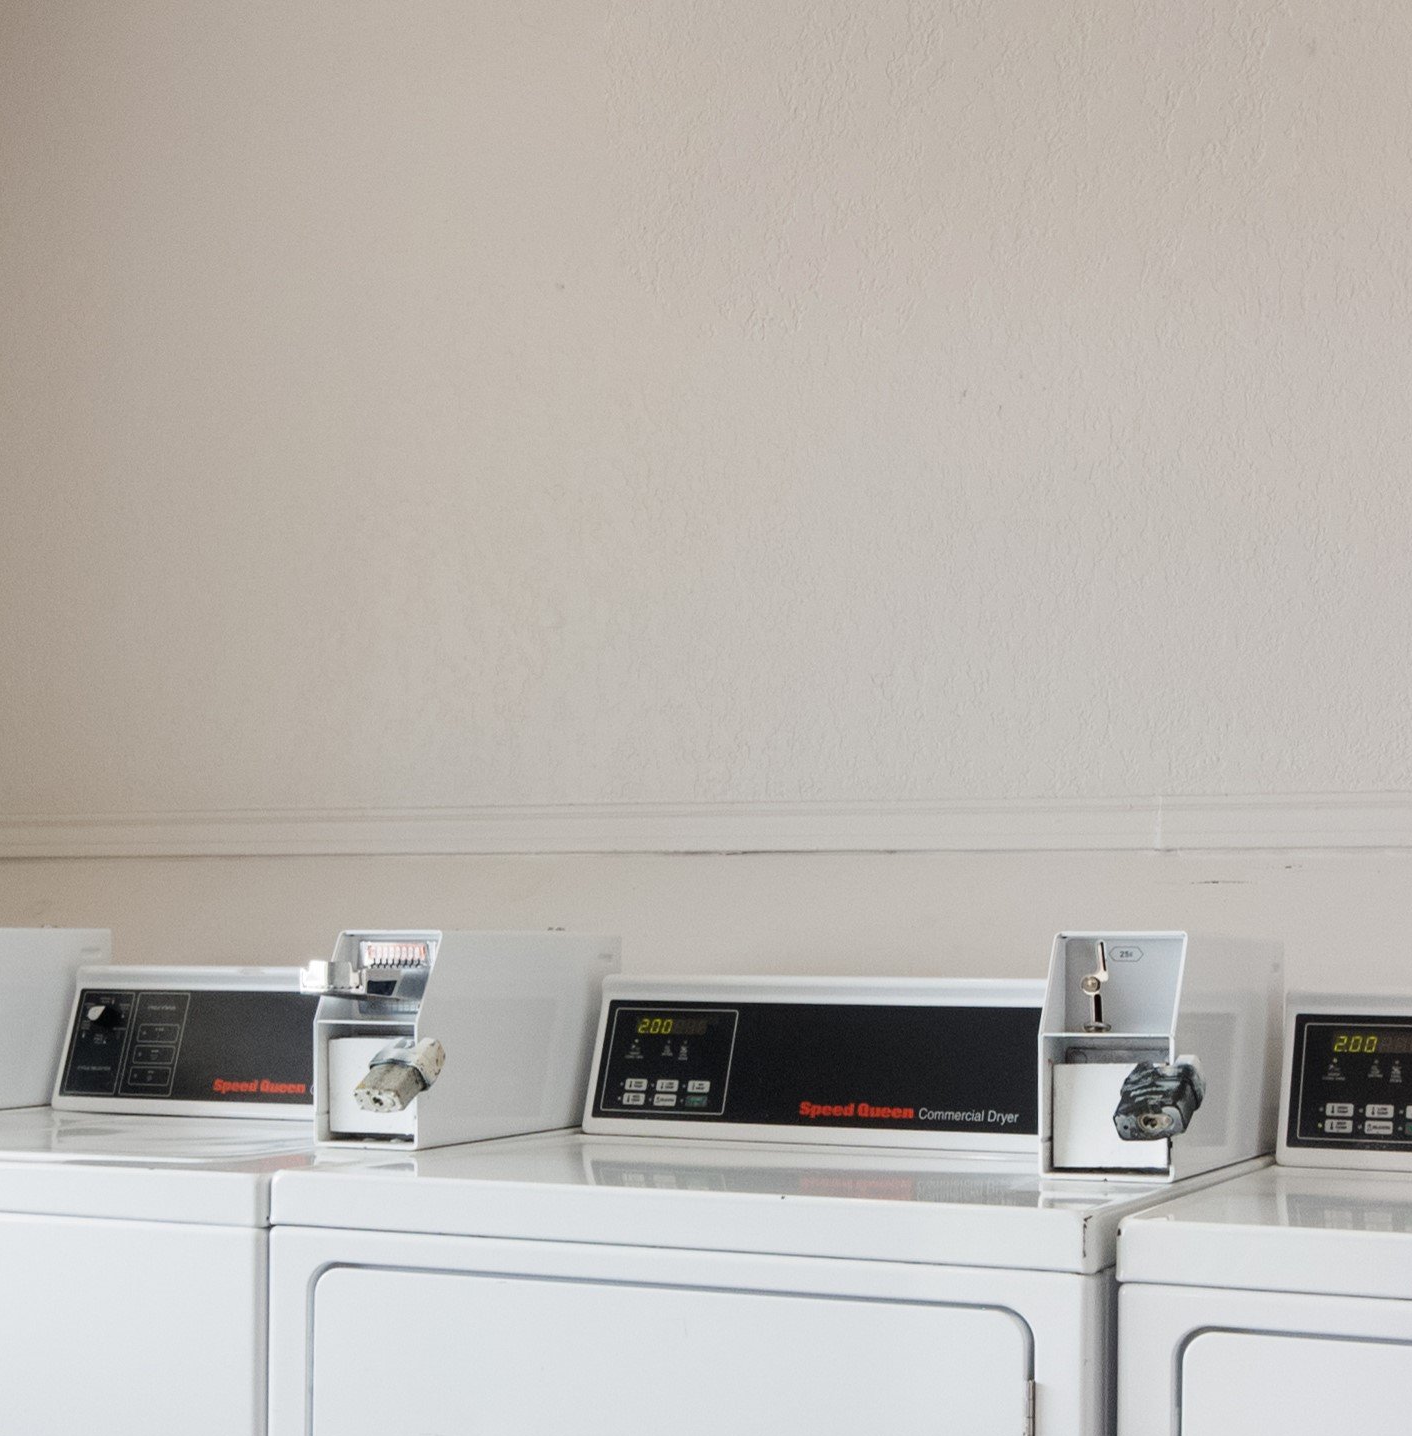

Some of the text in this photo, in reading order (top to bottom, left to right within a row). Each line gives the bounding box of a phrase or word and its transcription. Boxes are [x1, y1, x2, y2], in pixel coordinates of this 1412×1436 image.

[213, 1078, 258, 1094] Speed
[260, 1079, 306, 1094] Queen
[799, 1101, 1019, 1125] Speed Queen Commercial Dryer
